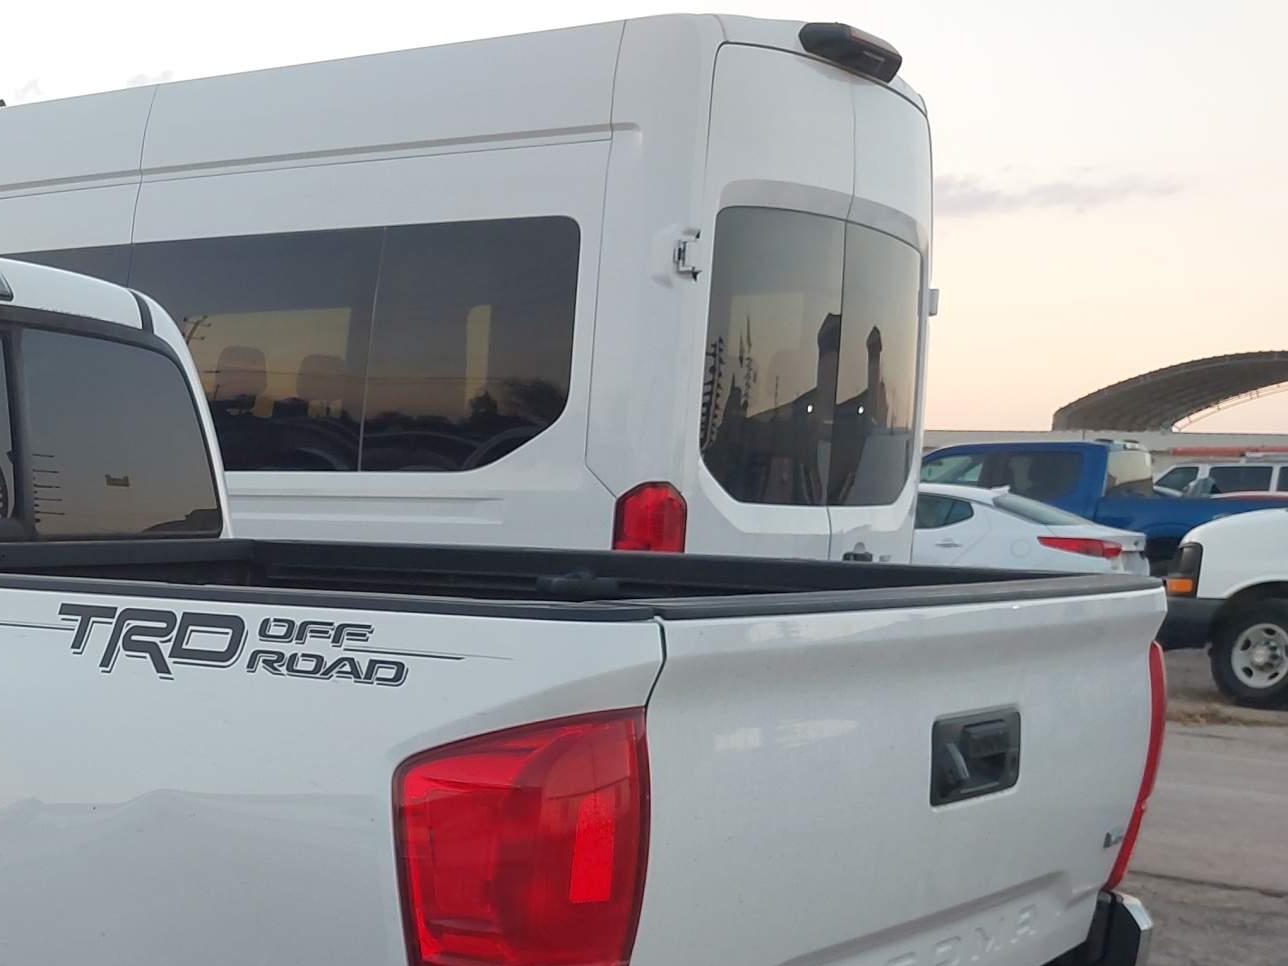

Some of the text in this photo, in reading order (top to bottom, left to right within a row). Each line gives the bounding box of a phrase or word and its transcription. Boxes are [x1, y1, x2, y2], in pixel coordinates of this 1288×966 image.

[57, 601, 248, 680] TRD
[258, 617, 374, 648] OFF
[246, 649, 409, 687] ROAD
